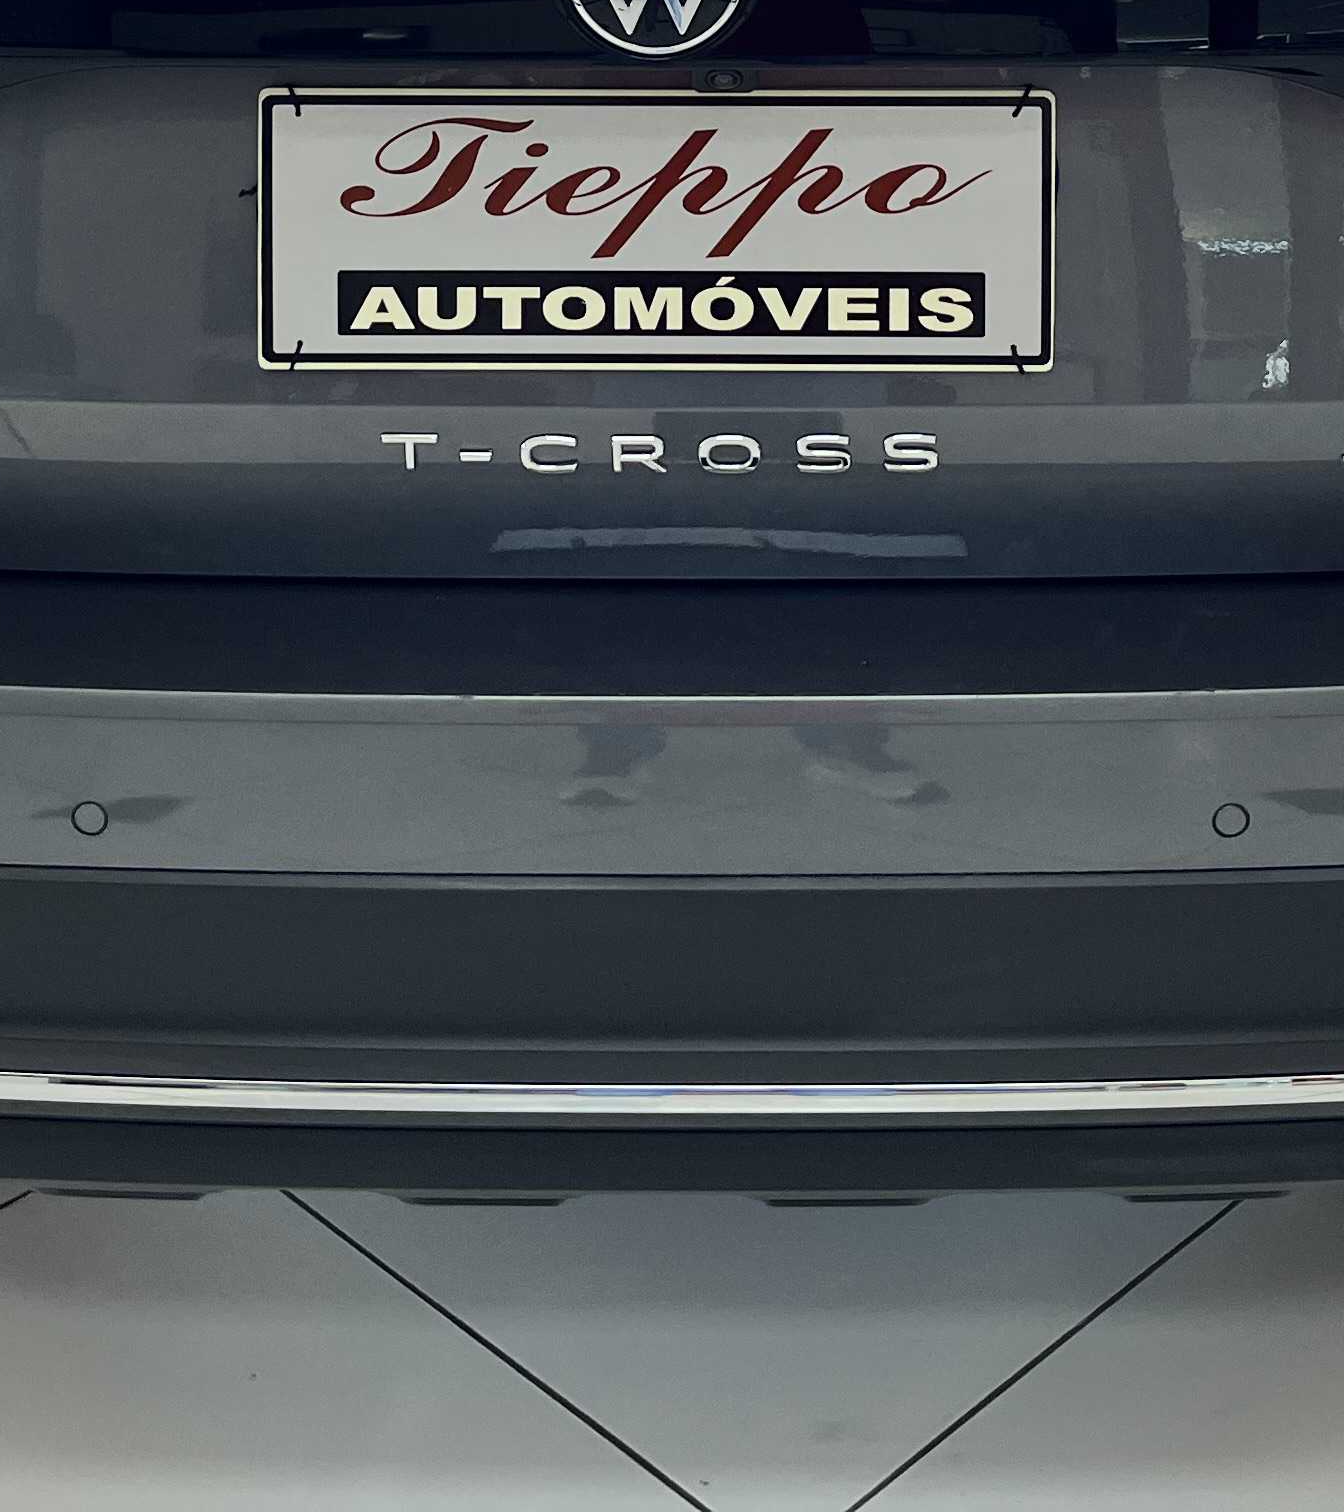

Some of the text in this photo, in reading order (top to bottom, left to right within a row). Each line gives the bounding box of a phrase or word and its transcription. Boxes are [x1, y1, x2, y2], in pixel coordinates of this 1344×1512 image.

[339, 116, 994, 258] Tieppo
[349, 276, 975, 332] AUTOMÓVEIS
[380, 431, 940, 474] T-CROSS
